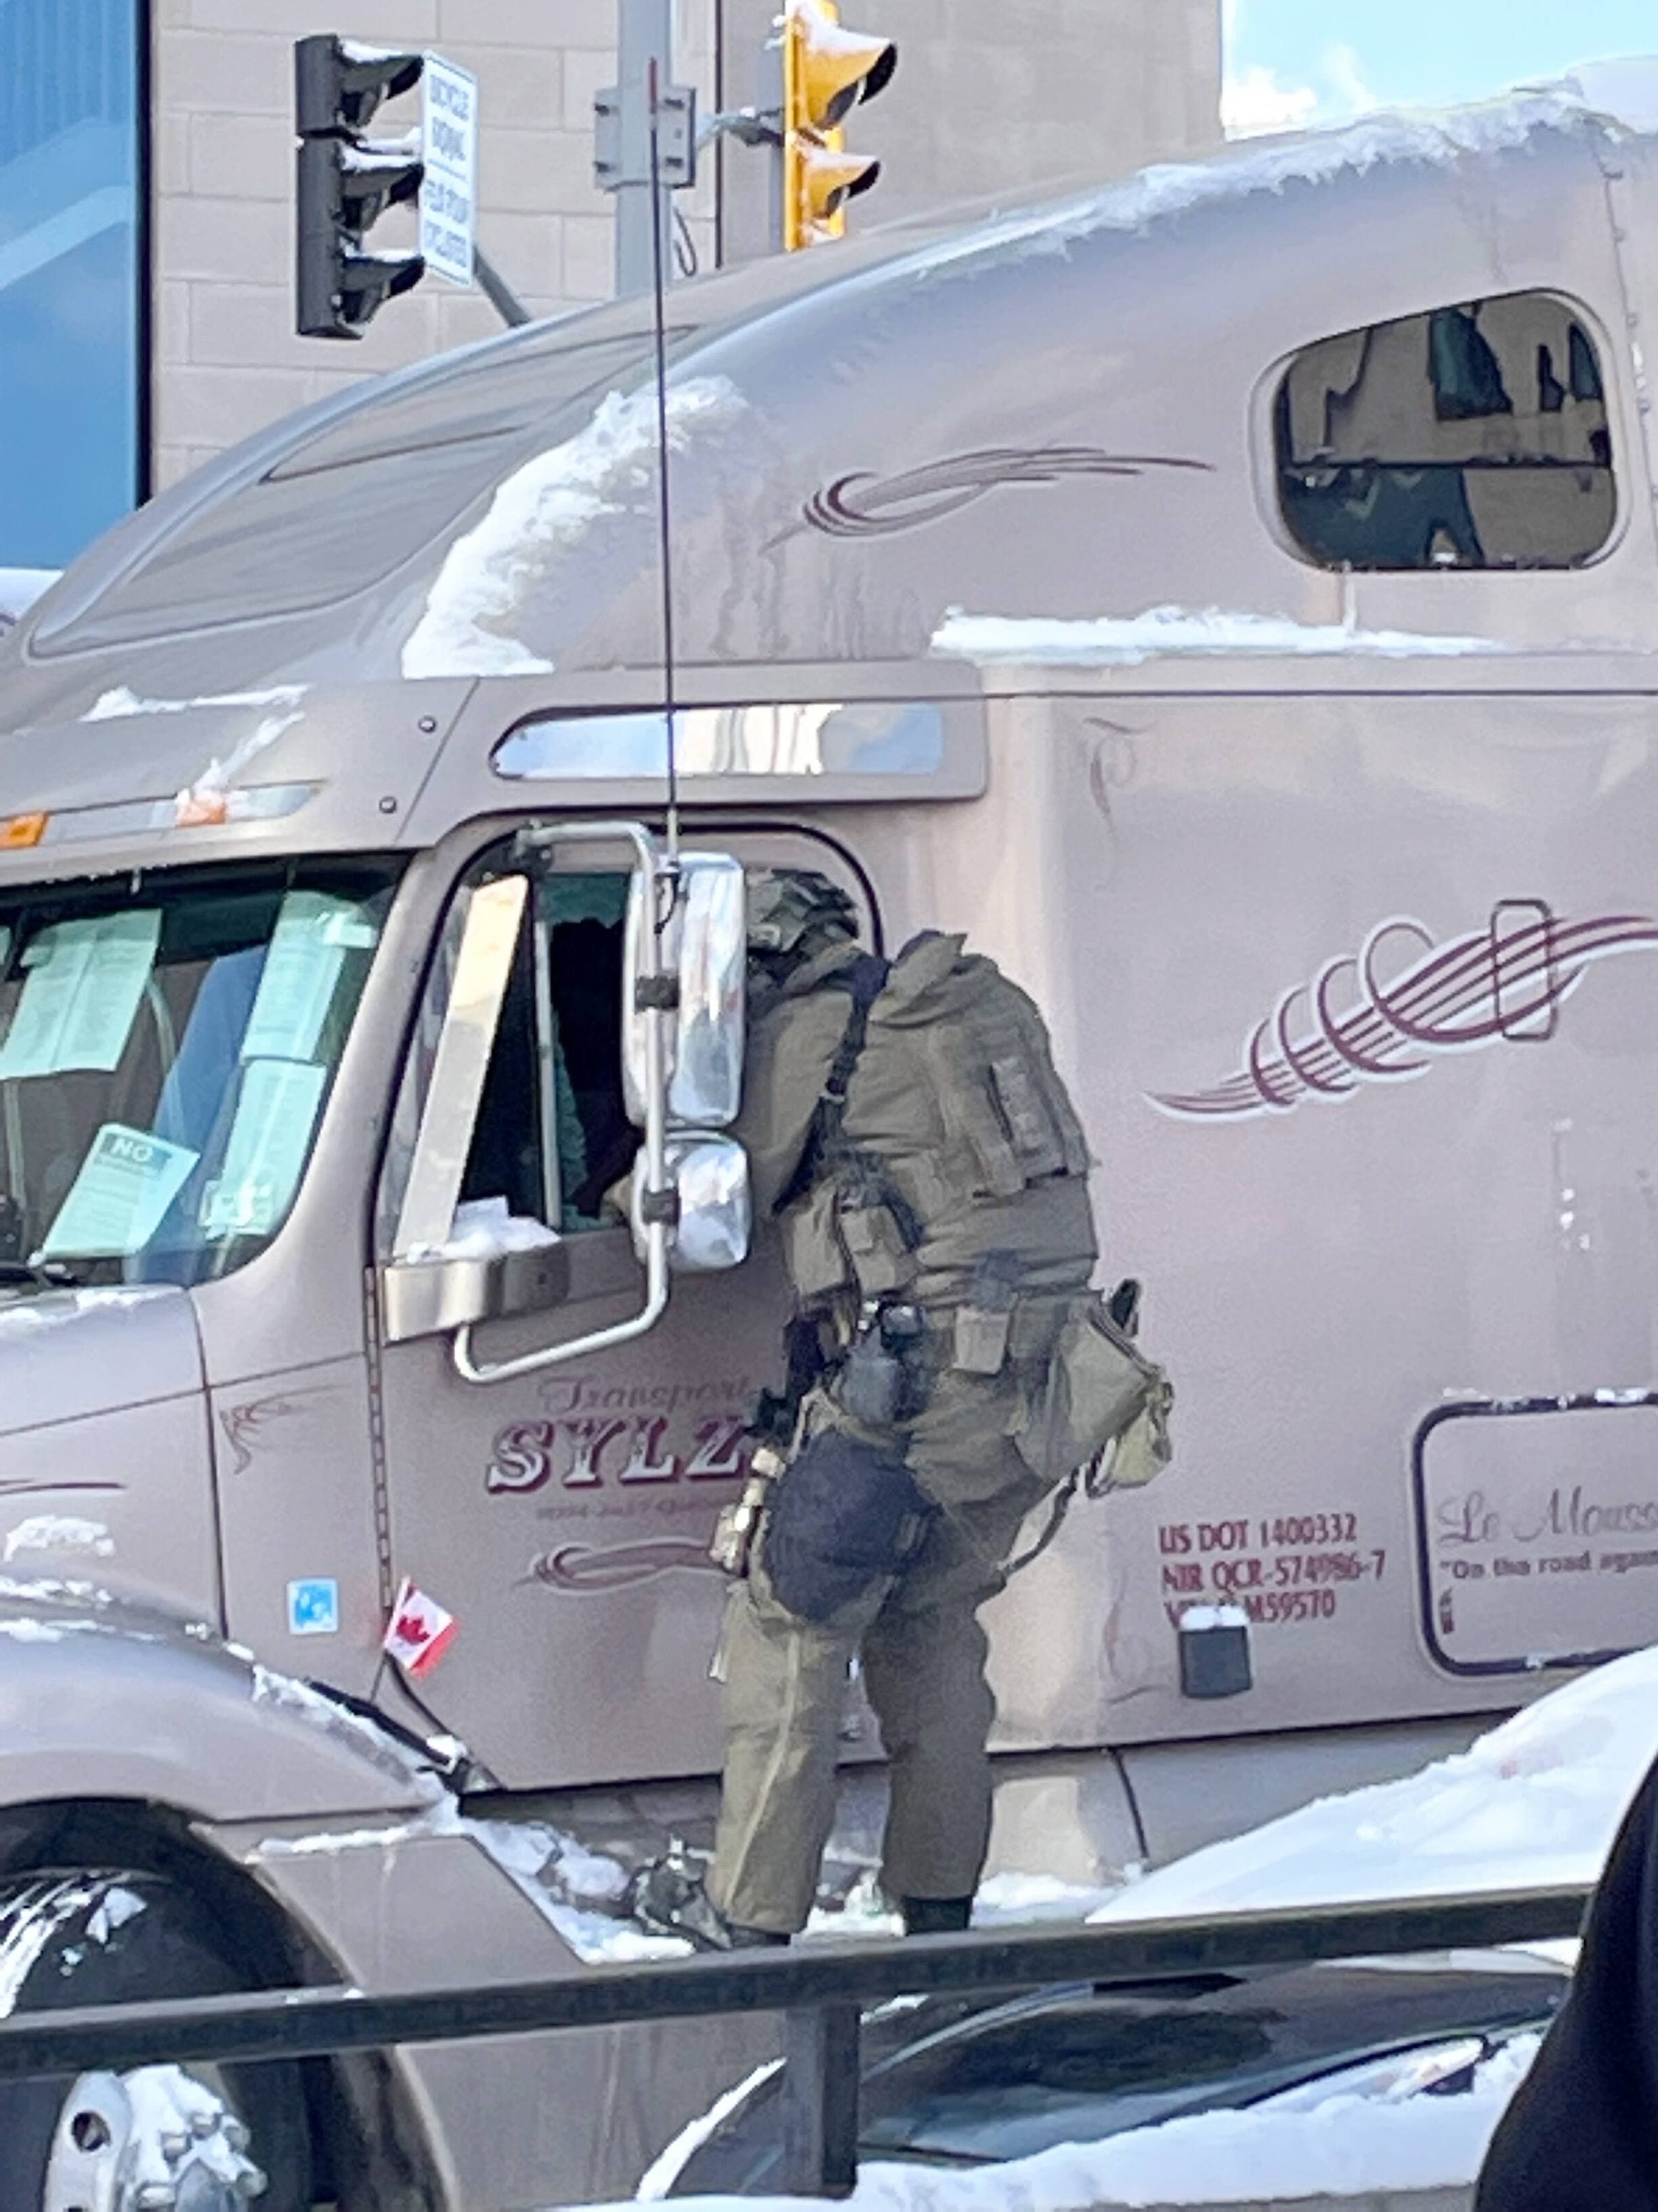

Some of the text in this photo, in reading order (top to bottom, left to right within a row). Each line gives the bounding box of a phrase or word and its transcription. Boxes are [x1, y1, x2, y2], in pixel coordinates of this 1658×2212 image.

[110, 1138, 154, 1162] NO
[1159, 1514, 1357, 1553] US DOT 1400332
[1538, 1550, 1590, 1574] road
